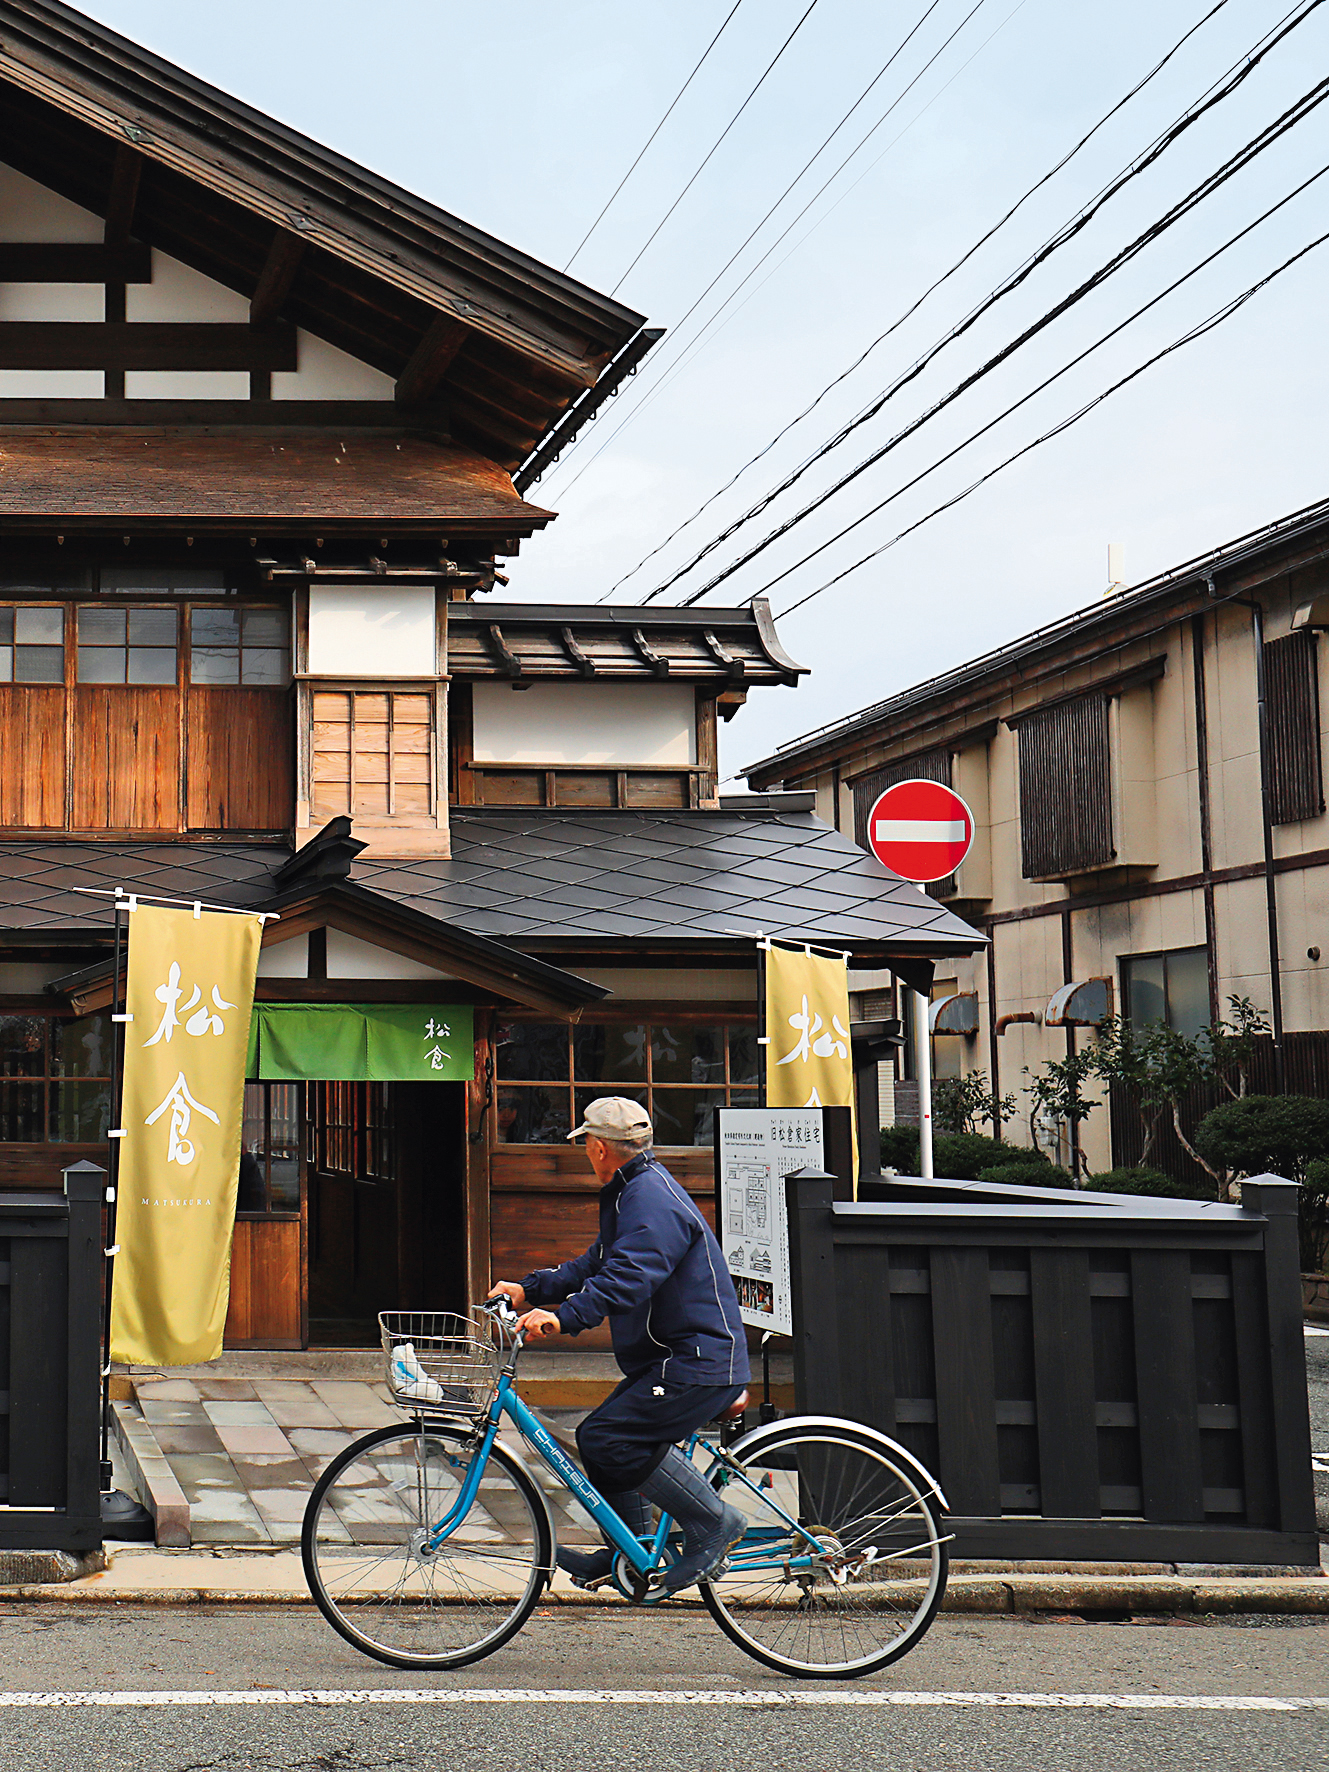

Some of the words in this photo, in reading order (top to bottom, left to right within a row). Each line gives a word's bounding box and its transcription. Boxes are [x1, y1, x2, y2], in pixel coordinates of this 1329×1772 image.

[141, 961, 239, 1166] 松倉
[423, 1017, 452, 1070] 松倉
[775, 993, 849, 1107] 松
[141, 1197, 211, 1206] MATSUKURA
